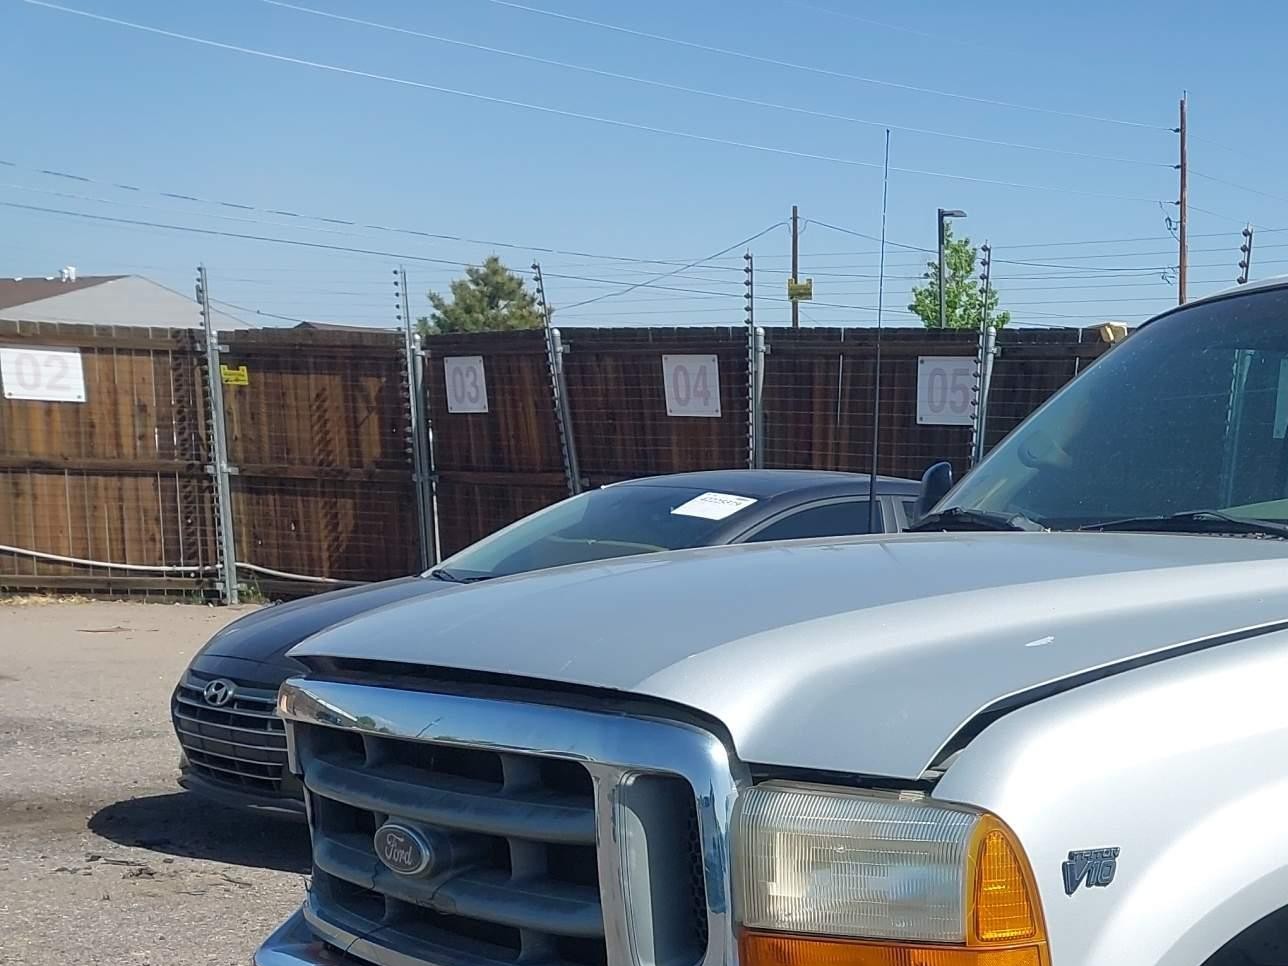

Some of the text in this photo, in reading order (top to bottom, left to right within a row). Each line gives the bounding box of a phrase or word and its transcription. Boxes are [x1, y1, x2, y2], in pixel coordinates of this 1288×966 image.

[15, 352, 72, 393] 02
[451, 366, 480, 404] 03
[672, 364, 711, 407] 04
[928, 367, 970, 414] 05
[384, 833, 412, 866] Ford
[1062, 859, 1116, 895] V10
